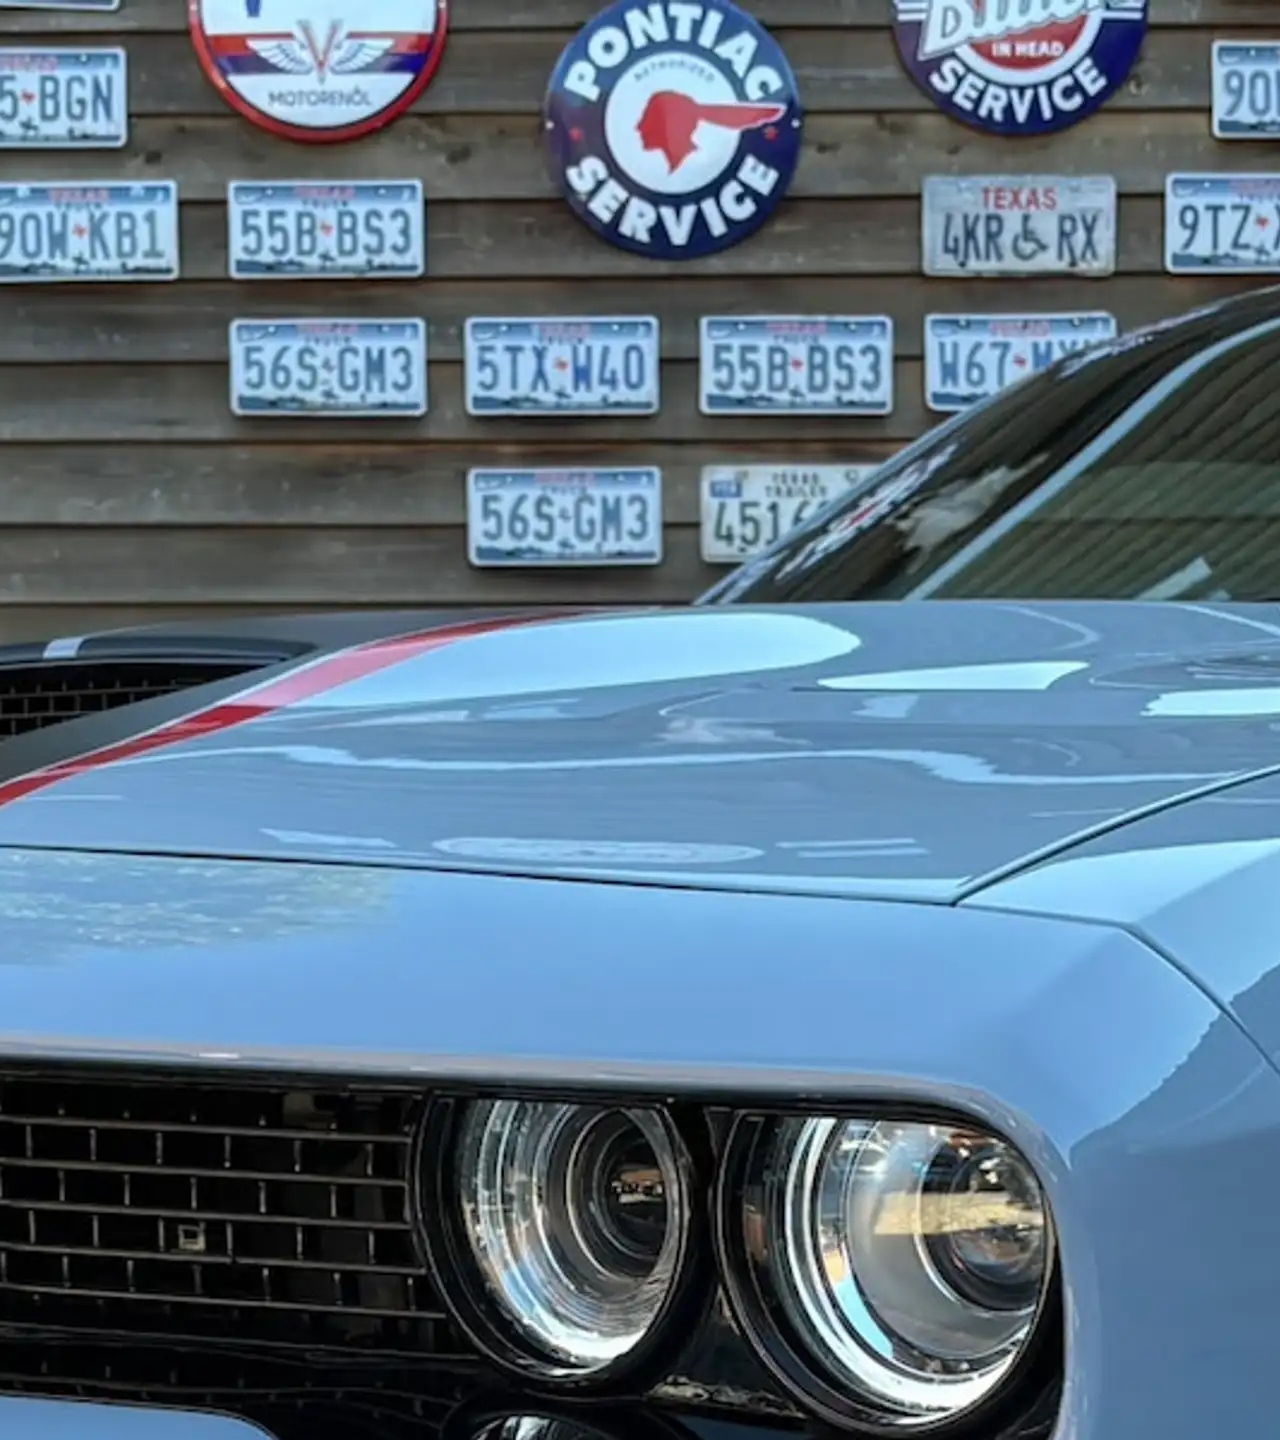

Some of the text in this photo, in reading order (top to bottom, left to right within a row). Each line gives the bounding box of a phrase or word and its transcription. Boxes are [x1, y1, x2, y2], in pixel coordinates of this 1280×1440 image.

[564, 3, 784, 102] PONTIAC
[1015, 40, 1065, 57] HEAD
[39, 74, 114, 122] BGN
[929, 56, 1108, 124] SERVICE
[565, 155, 780, 246] SERVICE
[982, 187, 1057, 211] TEXAS
[88, 211, 166, 260] KB1
[241, 209, 412, 257] 55B BS3
[1056, 213, 1102, 262] RX
[1178, 205, 1251, 250] 9TZ
[243, 345, 414, 392] 56S GM3
[477, 344, 550, 393] 5TX
[713, 344, 882, 393] 55B BS3
[481, 494, 650, 541] 56S GM3
